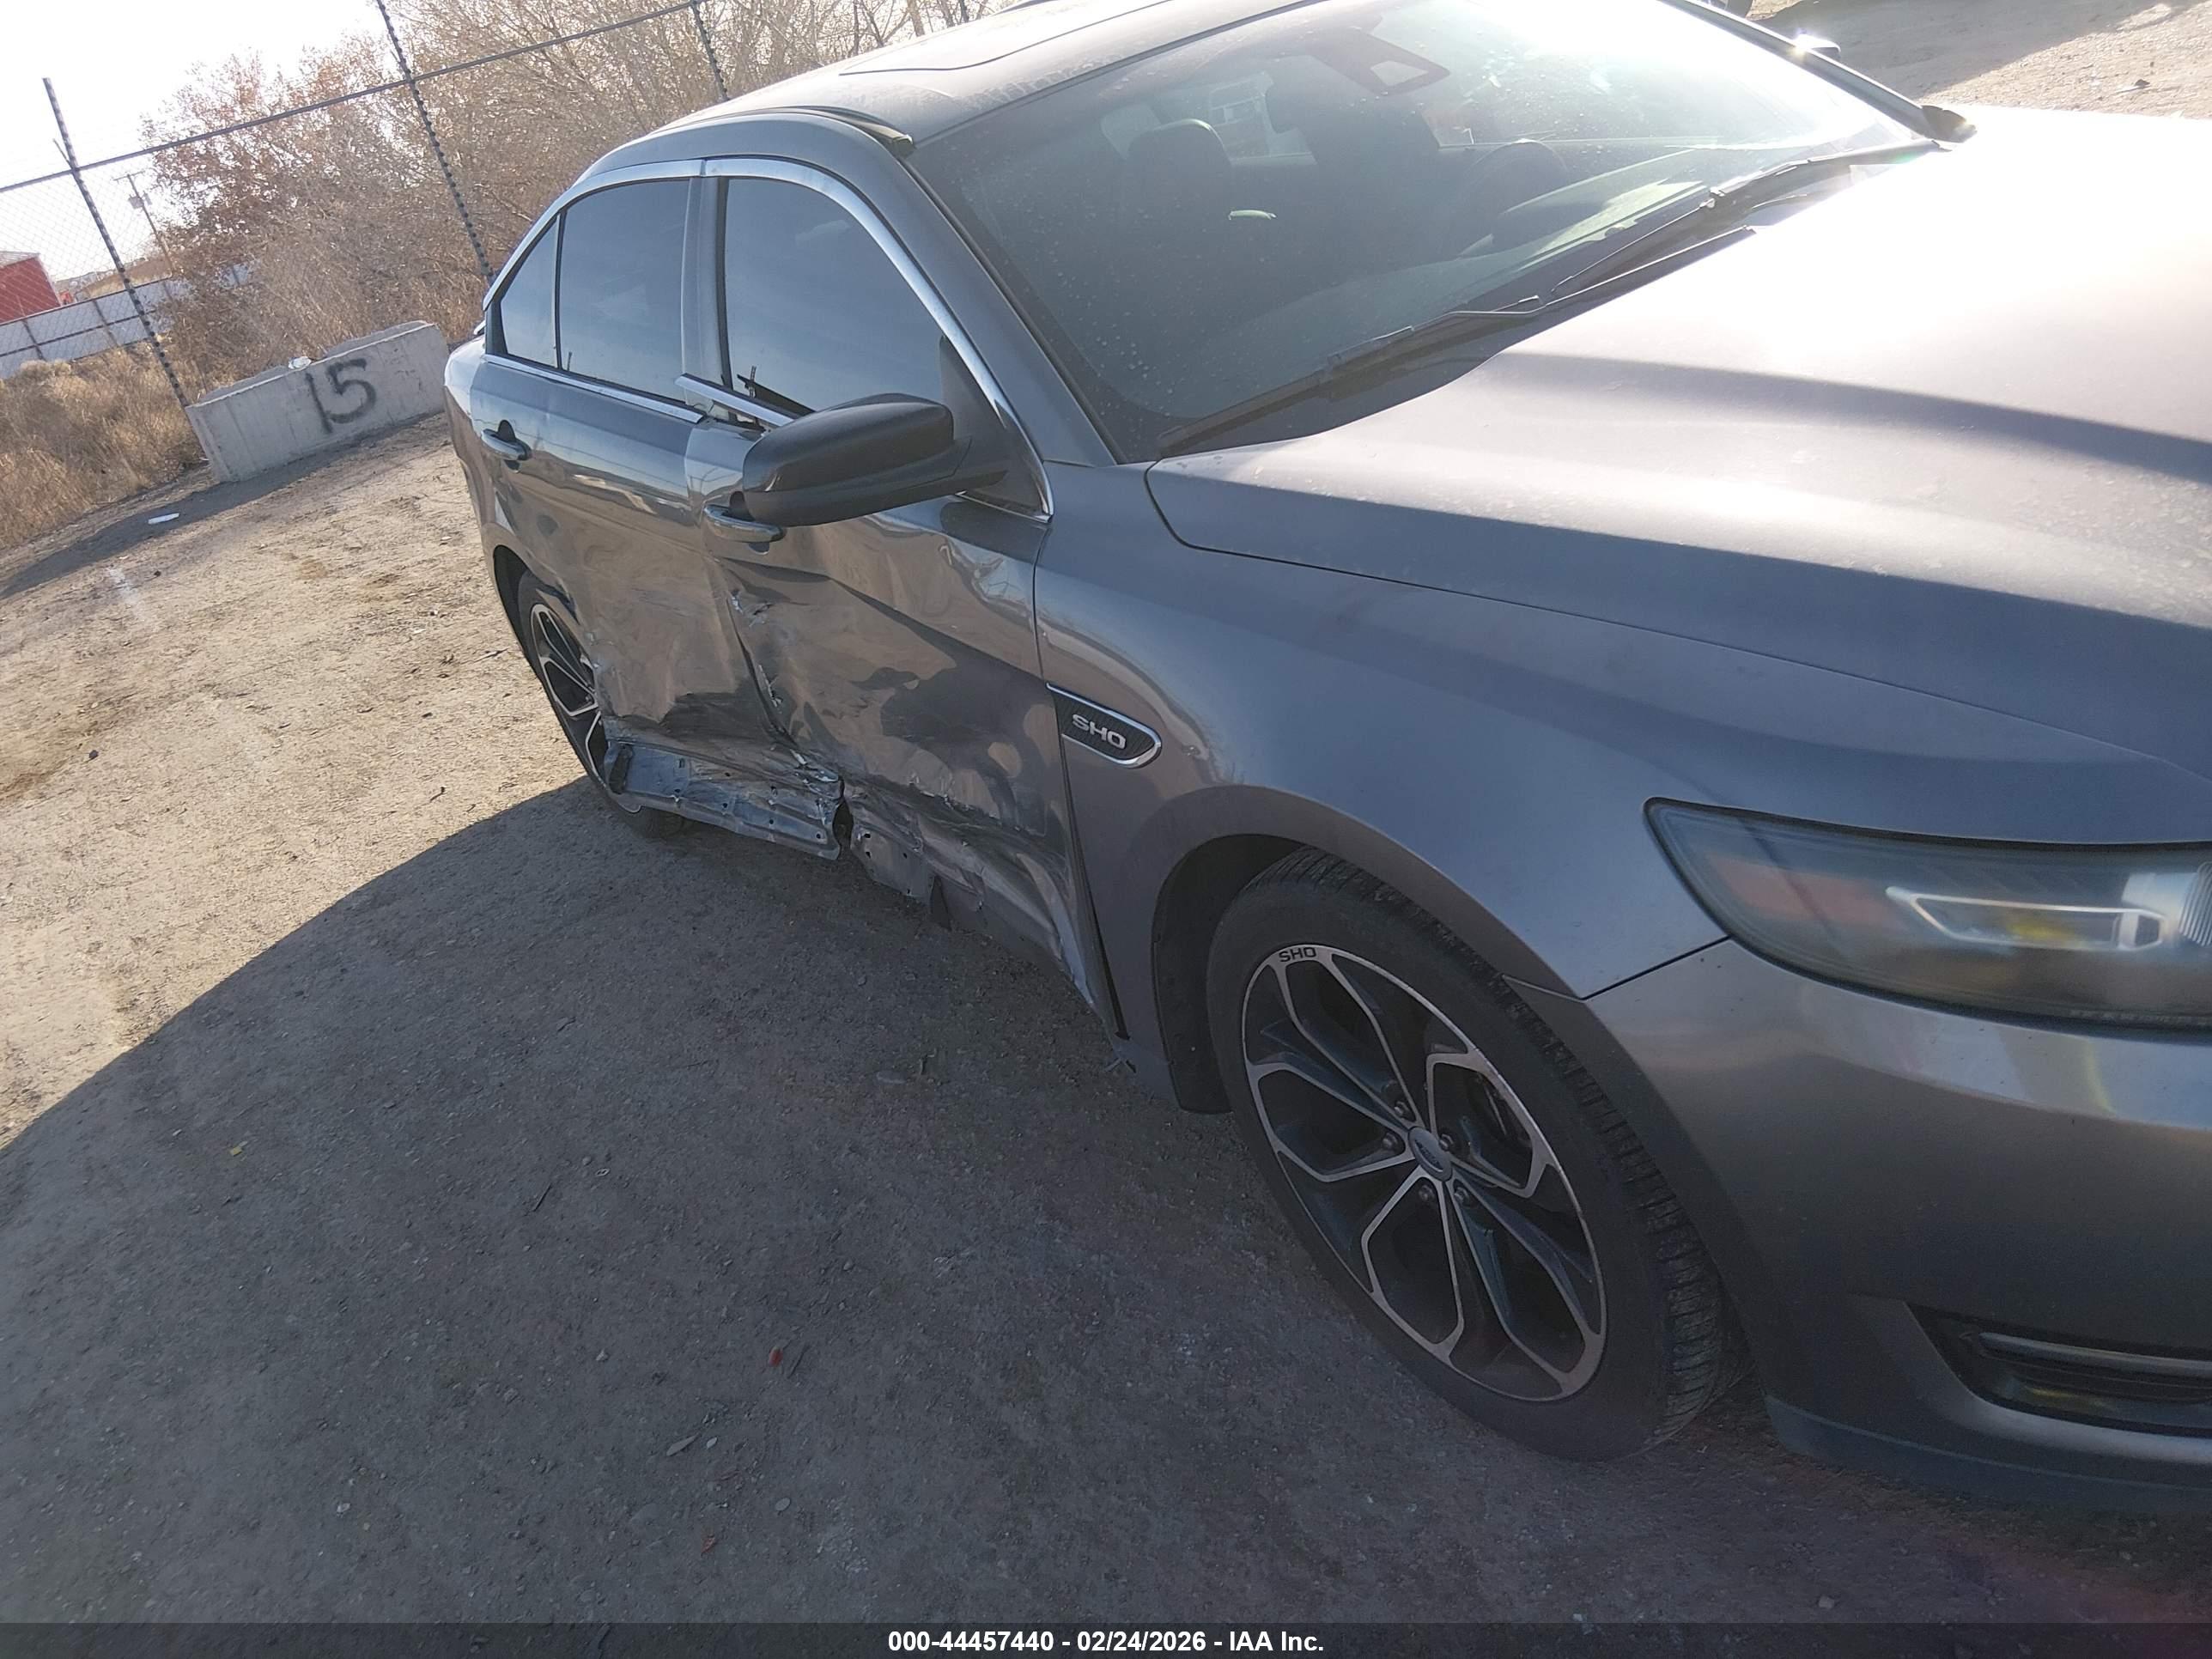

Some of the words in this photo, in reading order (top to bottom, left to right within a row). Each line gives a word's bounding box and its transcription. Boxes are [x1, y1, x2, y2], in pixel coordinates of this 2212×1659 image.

[306, 359, 376, 433] 15
[1073, 714, 1126, 749] SHO
[1279, 947, 1316, 963] SHO
